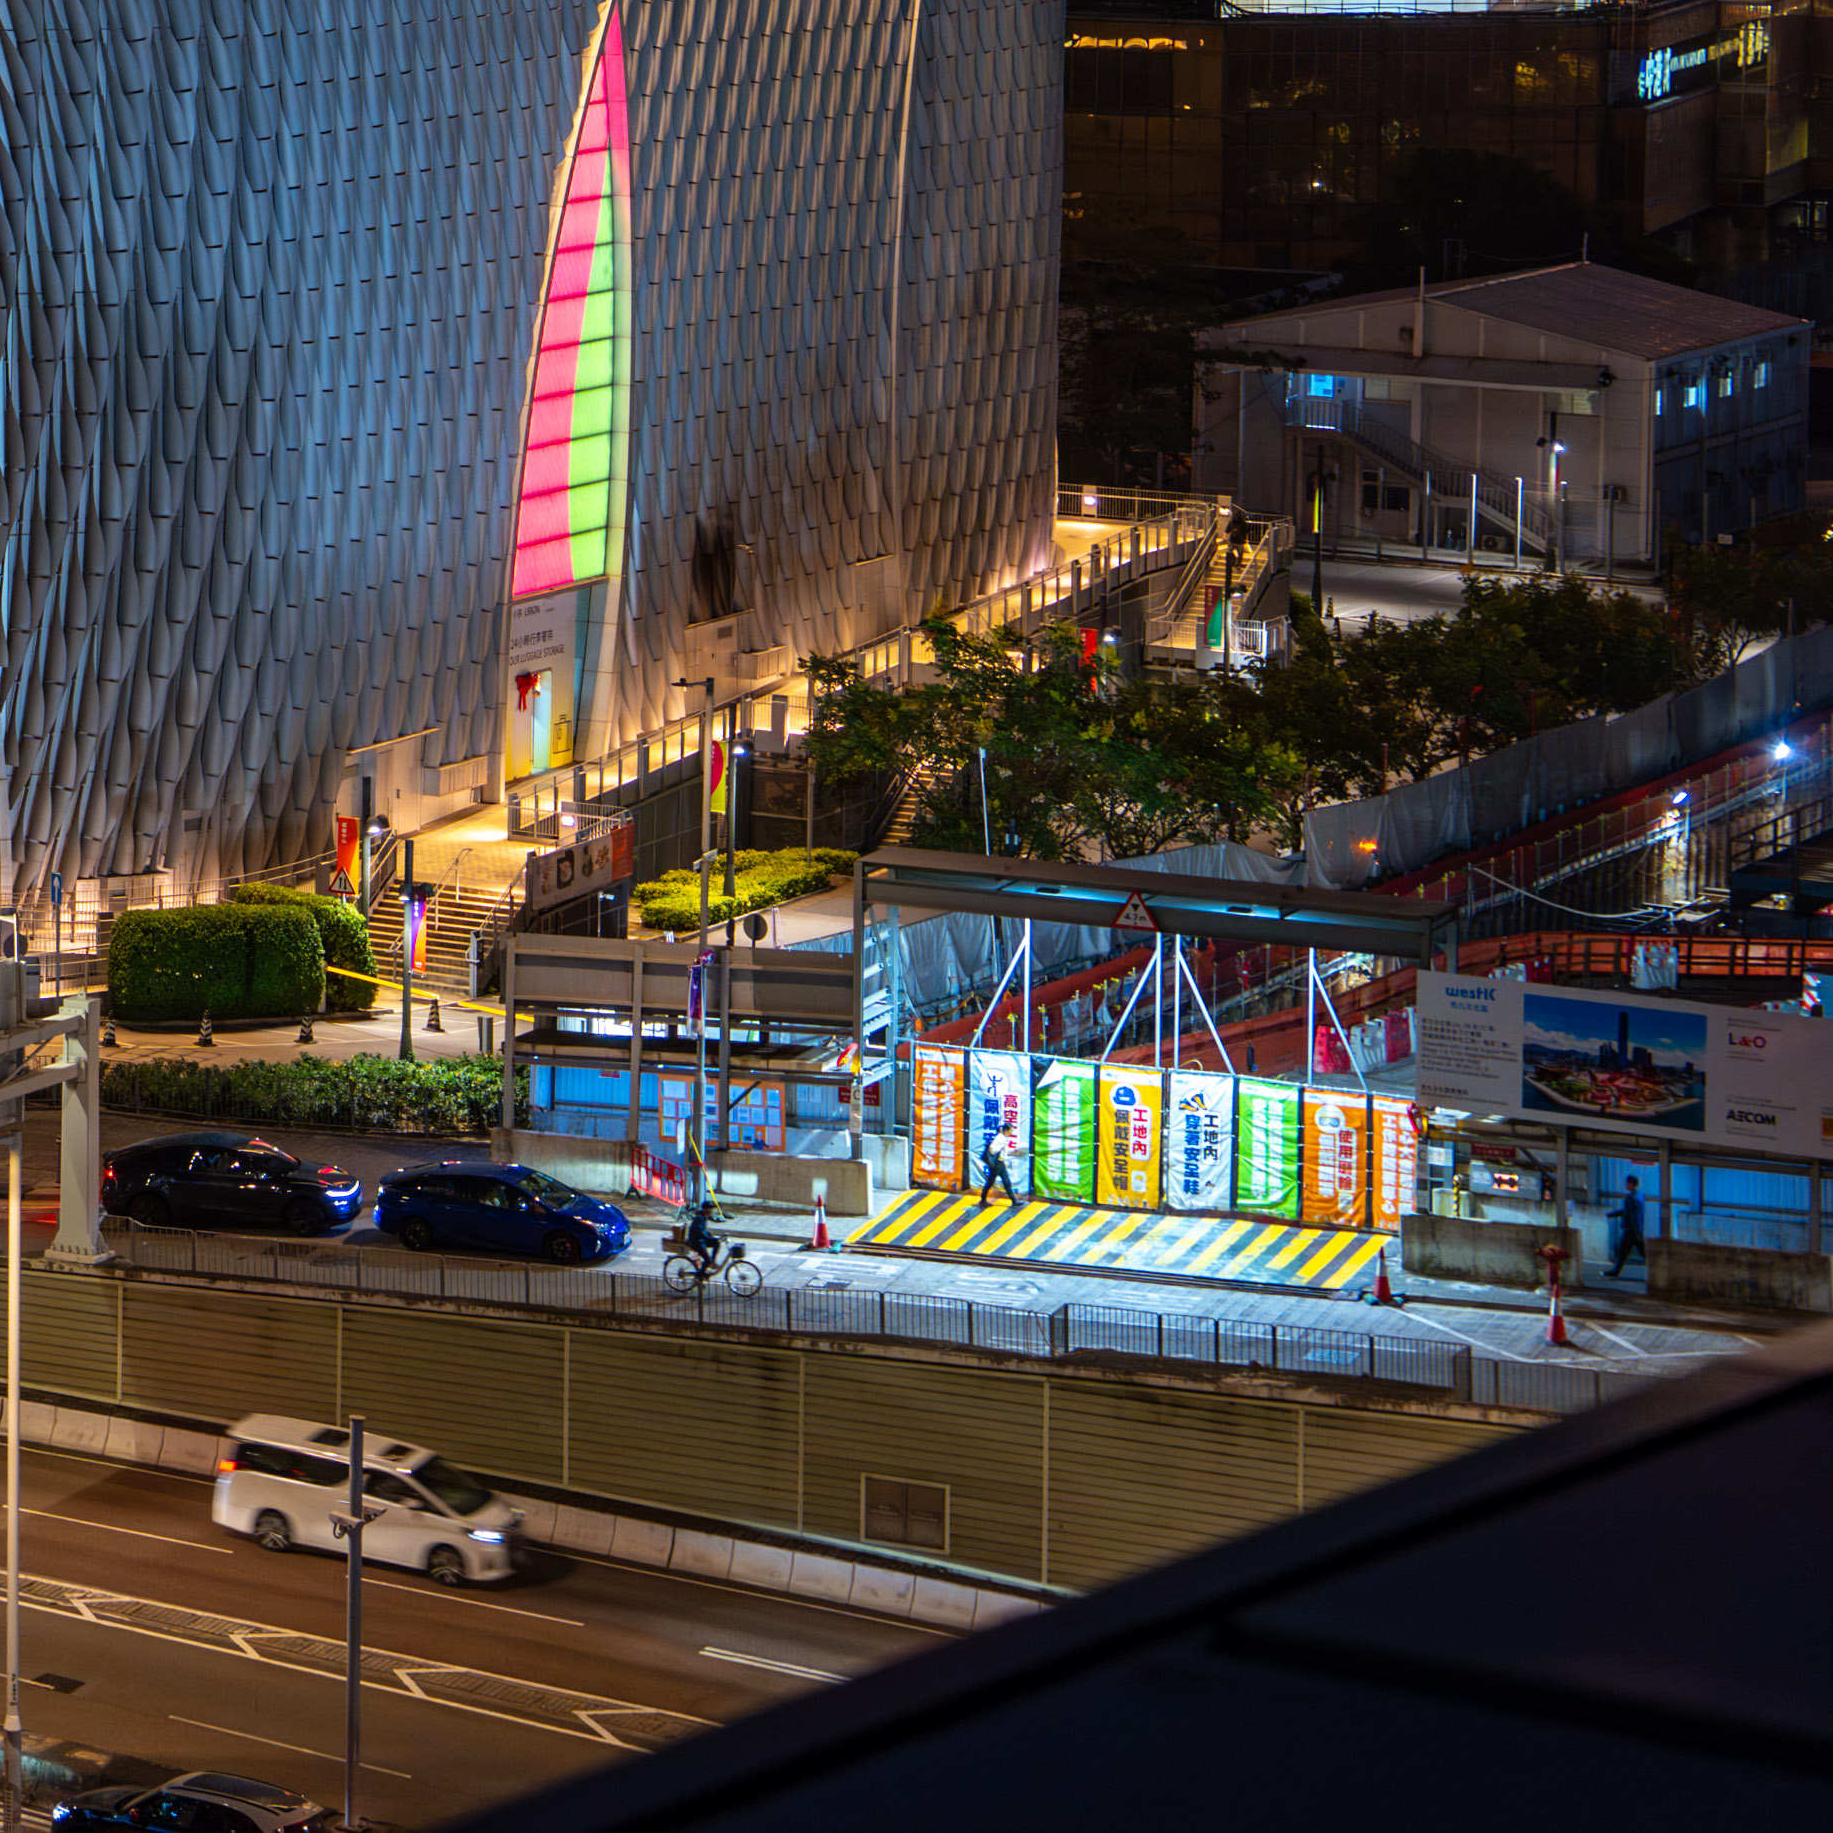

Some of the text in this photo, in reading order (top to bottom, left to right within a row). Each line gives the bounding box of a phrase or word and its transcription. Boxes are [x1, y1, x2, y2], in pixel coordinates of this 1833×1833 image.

[520, 648, 543, 663] LUGGAGE
[543, 643, 565, 657] STORAGE
[1728, 1032, 1767, 1049] L&O
[1132, 1108, 1148, 1156] 工地內
[1727, 1109, 1777, 1126] AECOM
[1112, 1108, 1129, 1191] 佩戴安全帽
[1203, 1114, 1219, 1161] 工地內
